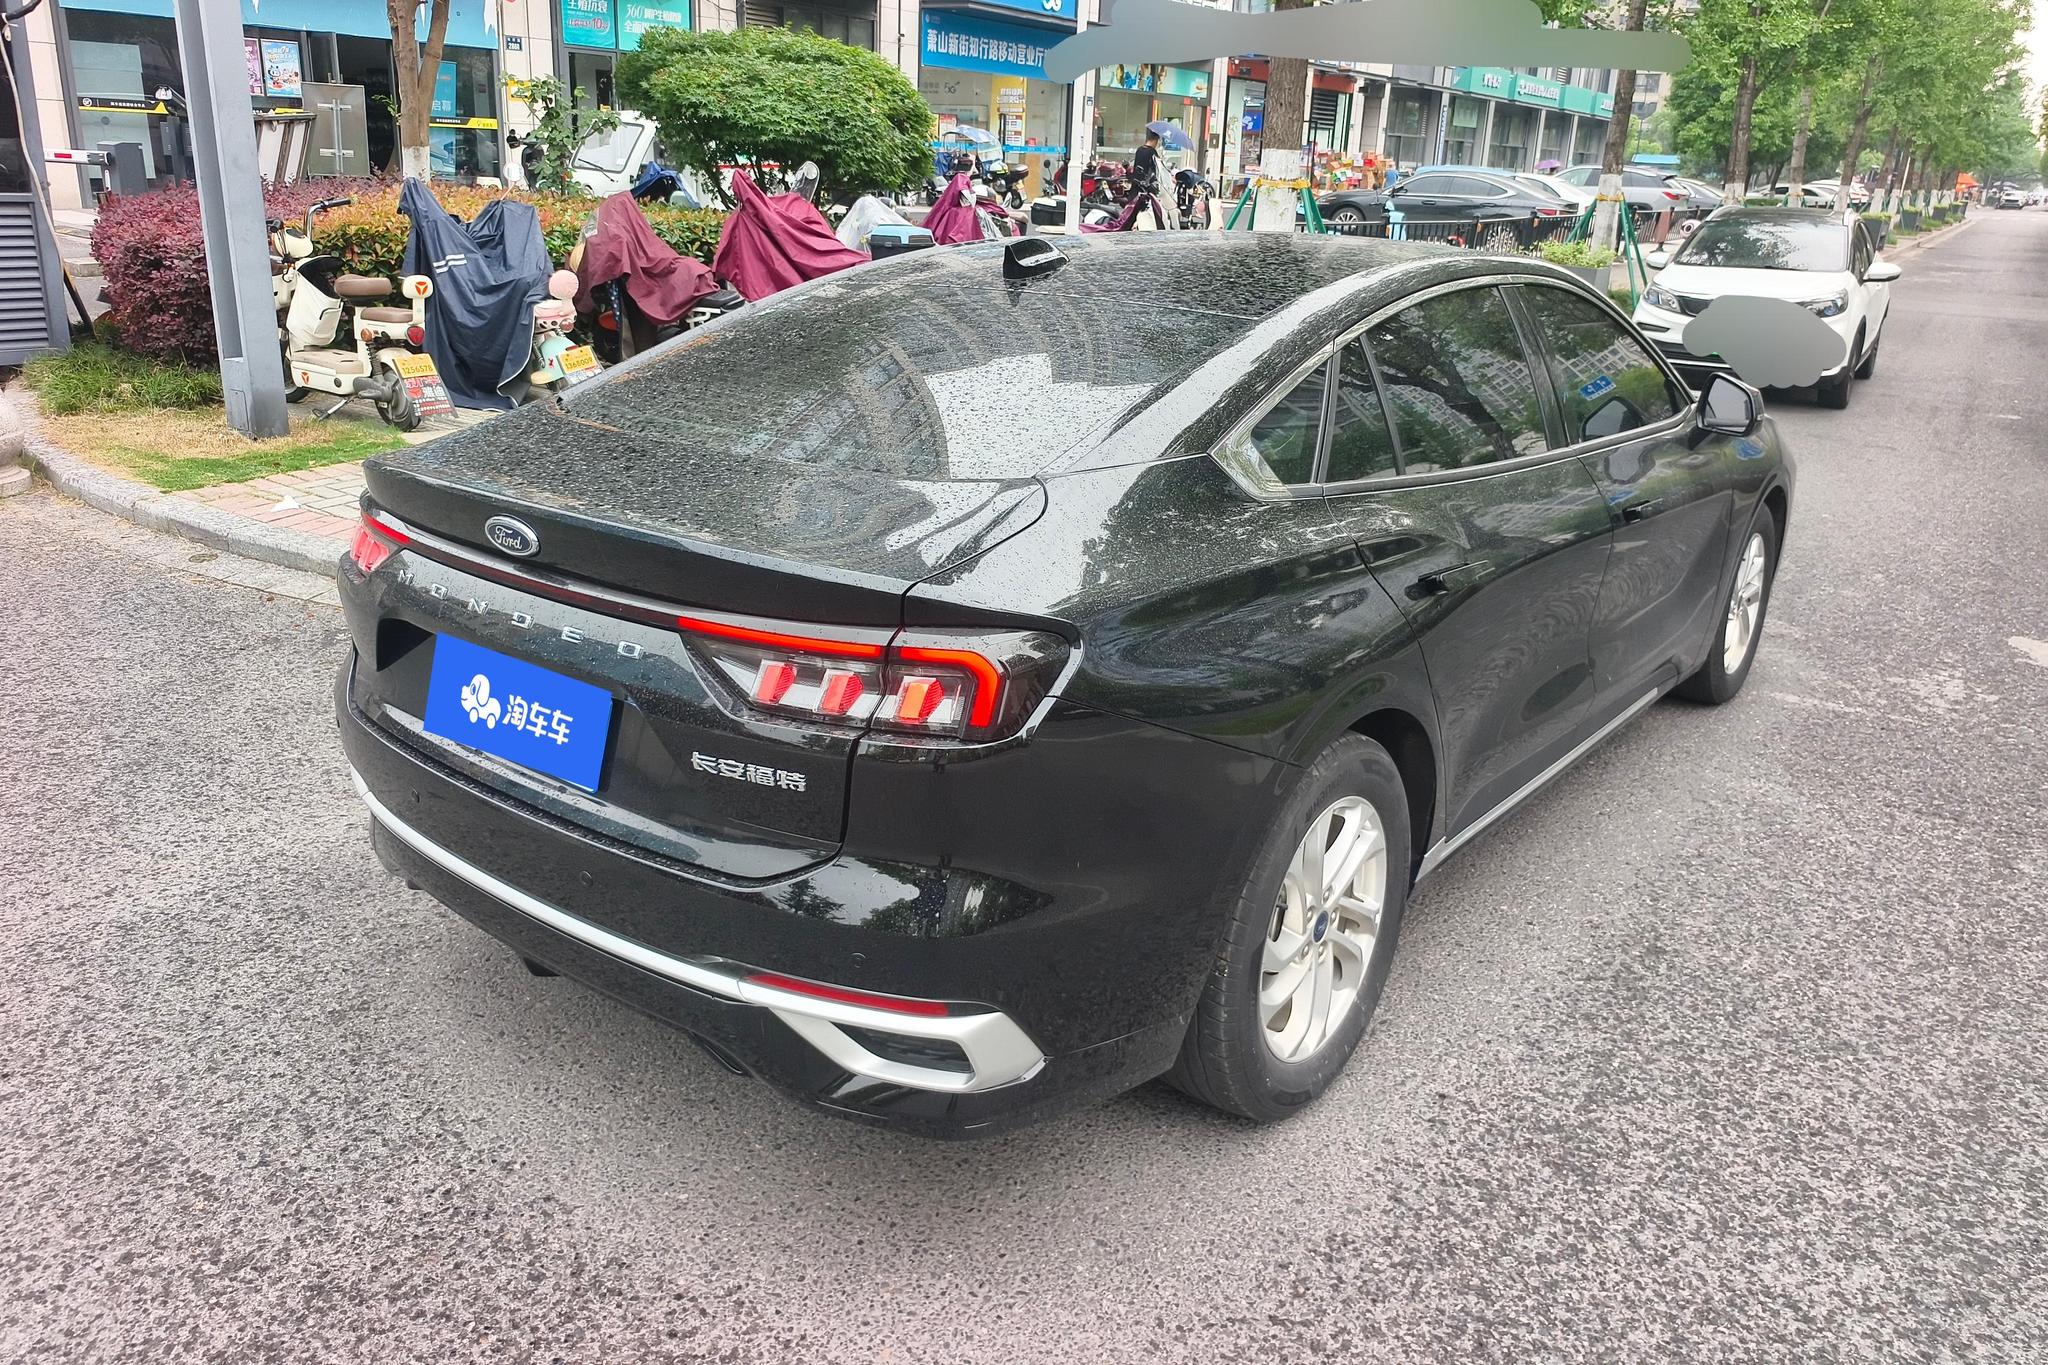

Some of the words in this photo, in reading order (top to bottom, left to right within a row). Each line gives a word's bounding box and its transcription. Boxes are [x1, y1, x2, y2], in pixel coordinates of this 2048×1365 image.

[927, 29, 1050, 68] 萧山新街知行路移动营业厅
[494, 525, 523, 549] Ford
[398, 569, 643, 659] MONDEO
[691, 751, 806, 792] 长安福特
